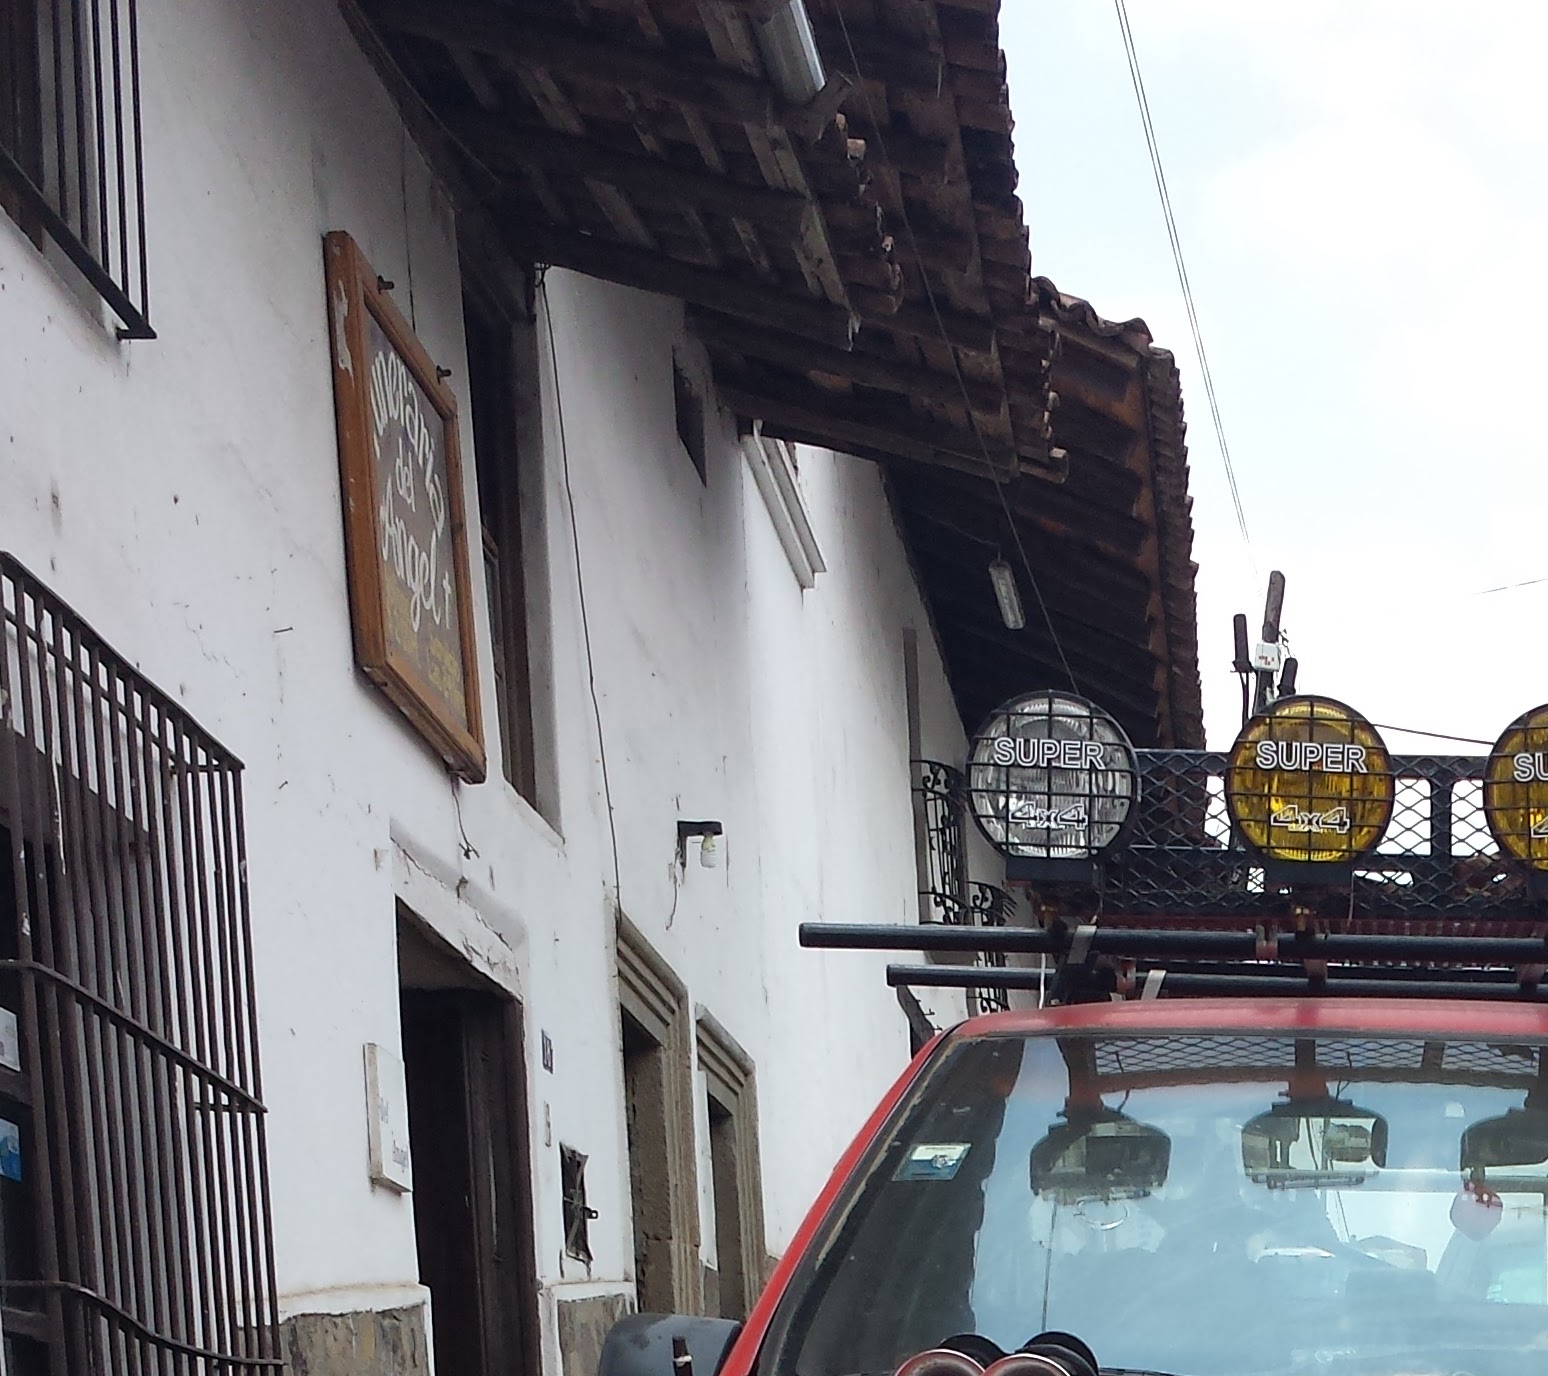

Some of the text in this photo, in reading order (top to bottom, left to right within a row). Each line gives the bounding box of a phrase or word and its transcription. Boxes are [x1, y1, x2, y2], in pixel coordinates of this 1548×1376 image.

[370, 351, 445, 538] uneraria
[395, 437, 416, 513] del
[380, 473, 442, 632] Angel
[993, 737, 1106, 771] SUPER
[1255, 740, 1369, 774] SUPER
[1008, 801, 1089, 831] 4x4
[1270, 804, 1351, 835] 4x4
